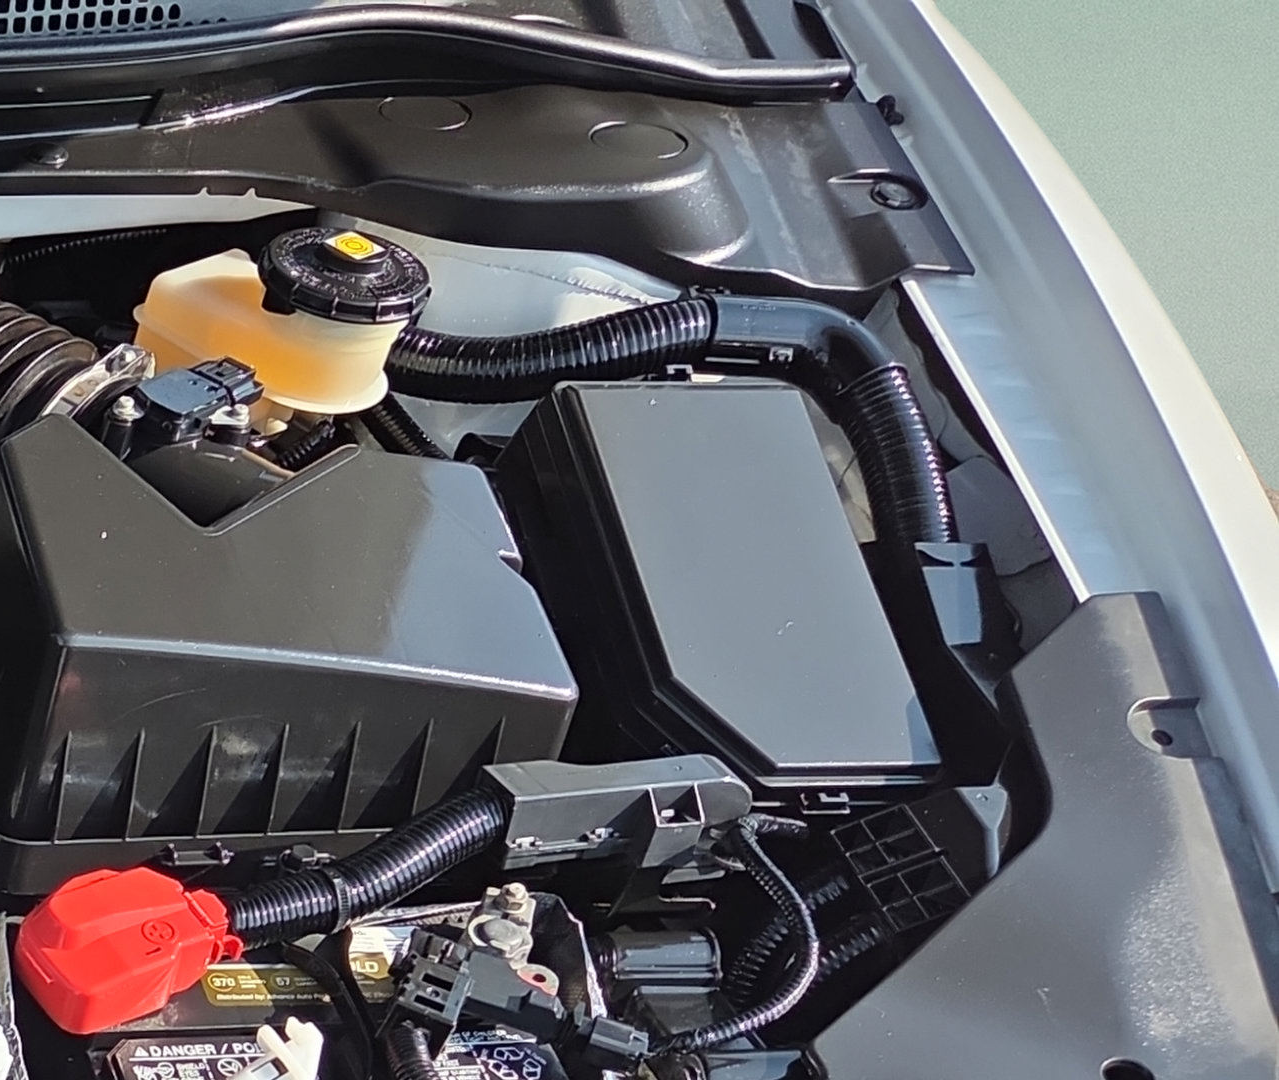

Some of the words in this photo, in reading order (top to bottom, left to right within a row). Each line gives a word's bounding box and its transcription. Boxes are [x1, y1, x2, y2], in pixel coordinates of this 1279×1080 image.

[212, 977, 236, 987] 370
[216, 993, 254, 1001] Distributed
[149, 1043, 217, 1057] DANGER
